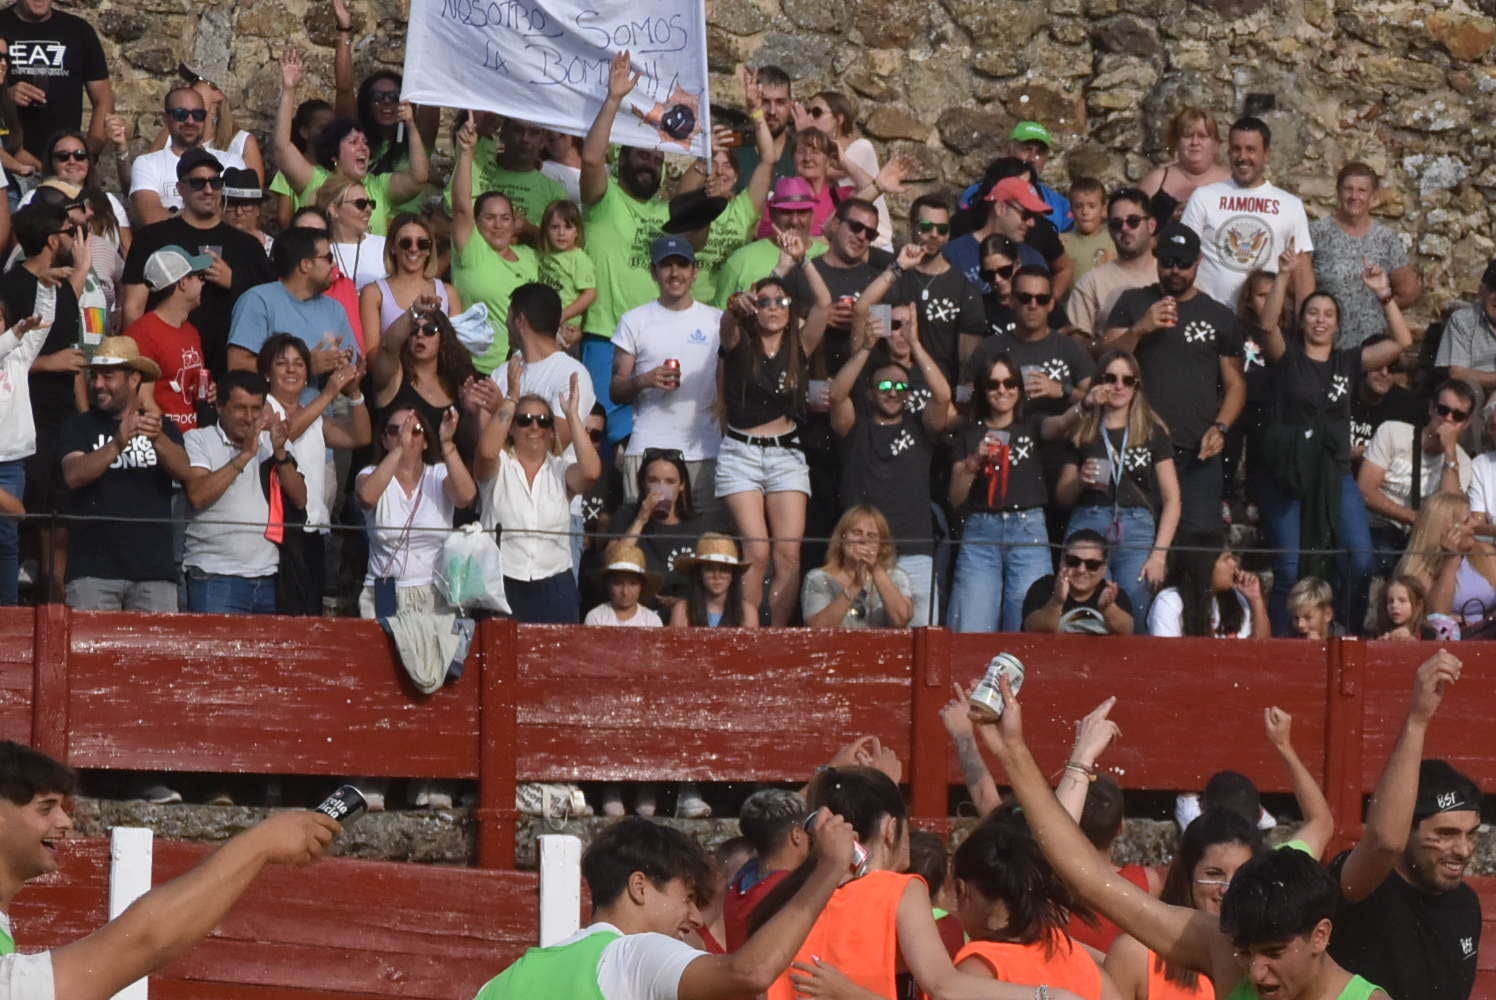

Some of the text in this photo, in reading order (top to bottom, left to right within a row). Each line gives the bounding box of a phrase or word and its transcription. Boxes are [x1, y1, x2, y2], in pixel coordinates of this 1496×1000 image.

[575, 10, 688, 53] SOMOS
[8, 44, 67, 66] EA7
[483, 40, 510, 73] LA
[1219, 196, 1280, 215] RAMONES
